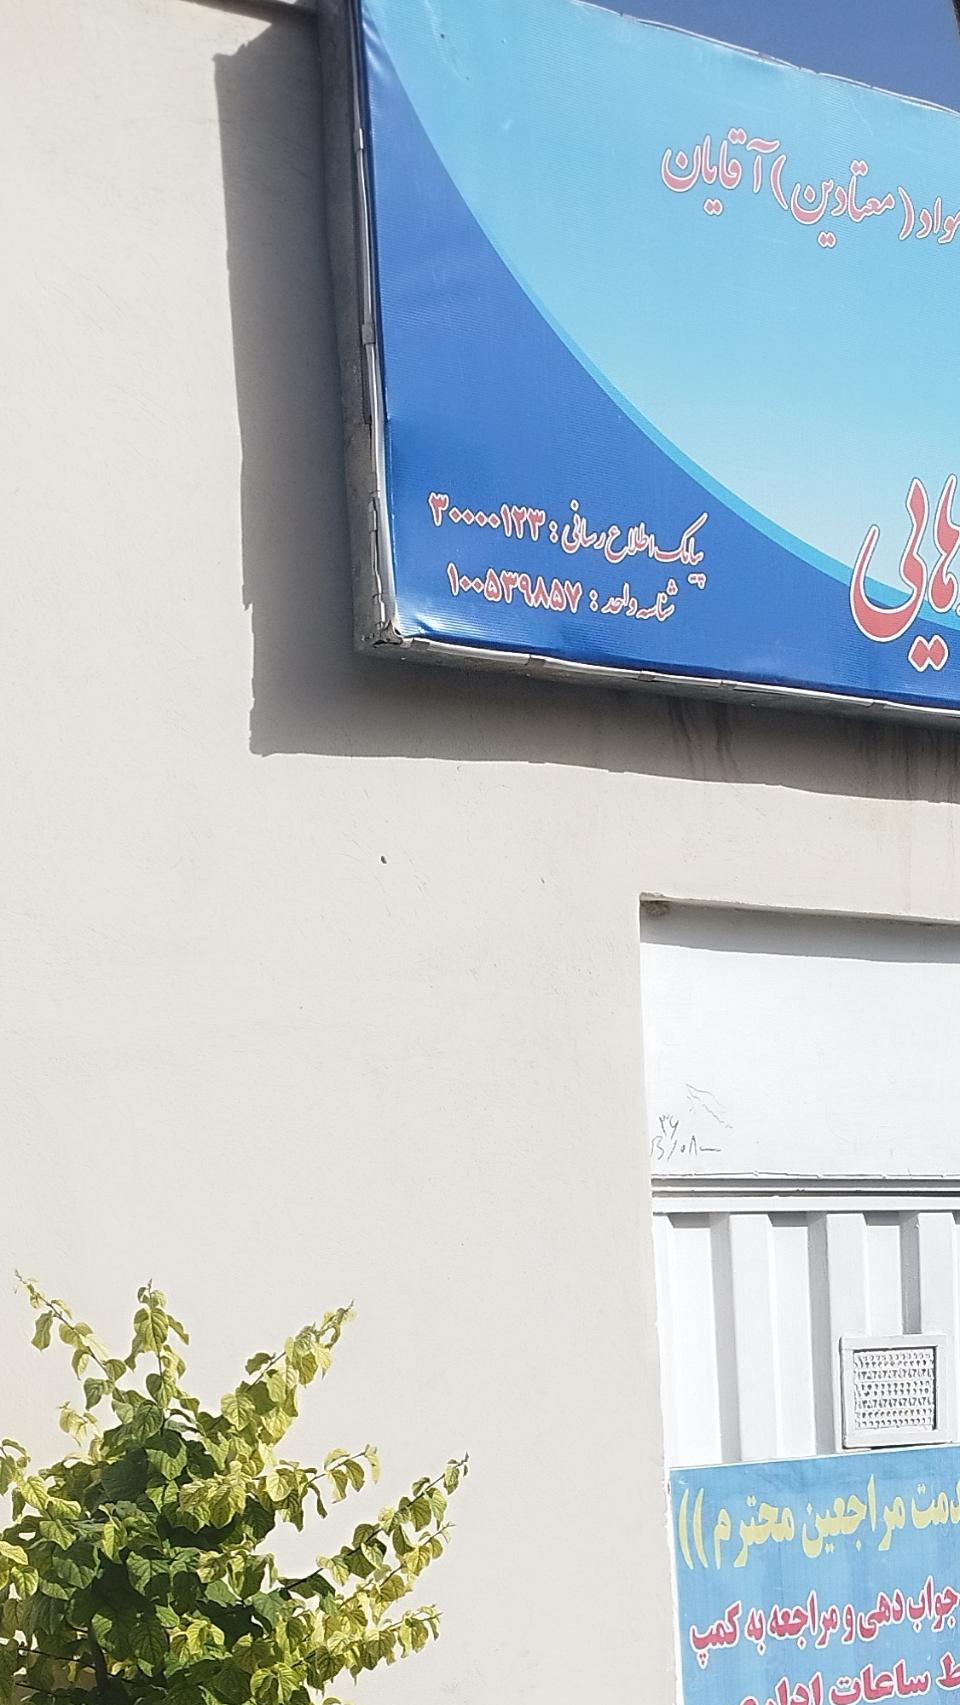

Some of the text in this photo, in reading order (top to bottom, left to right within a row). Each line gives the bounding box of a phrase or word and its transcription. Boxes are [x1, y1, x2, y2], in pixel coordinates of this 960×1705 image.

[662, 128, 781, 216] آقایان
[429, 492, 546, 540] ۳۰۰۰۰۱۲۳
[447, 562, 582, 613] ۱۰۰۵۳۹۸۵۷
[802, 1474, 906, 1558] مراجعین
[745, 1608, 767, 1655] به
[768, 1589, 840, 1649] مراجعه
[842, 1603, 854, 1644] و
[858, 1588, 905, 1641] دهی
[907, 1577, 959, 1633] جواب
[690, 1601, 742, 1669] کمپ
